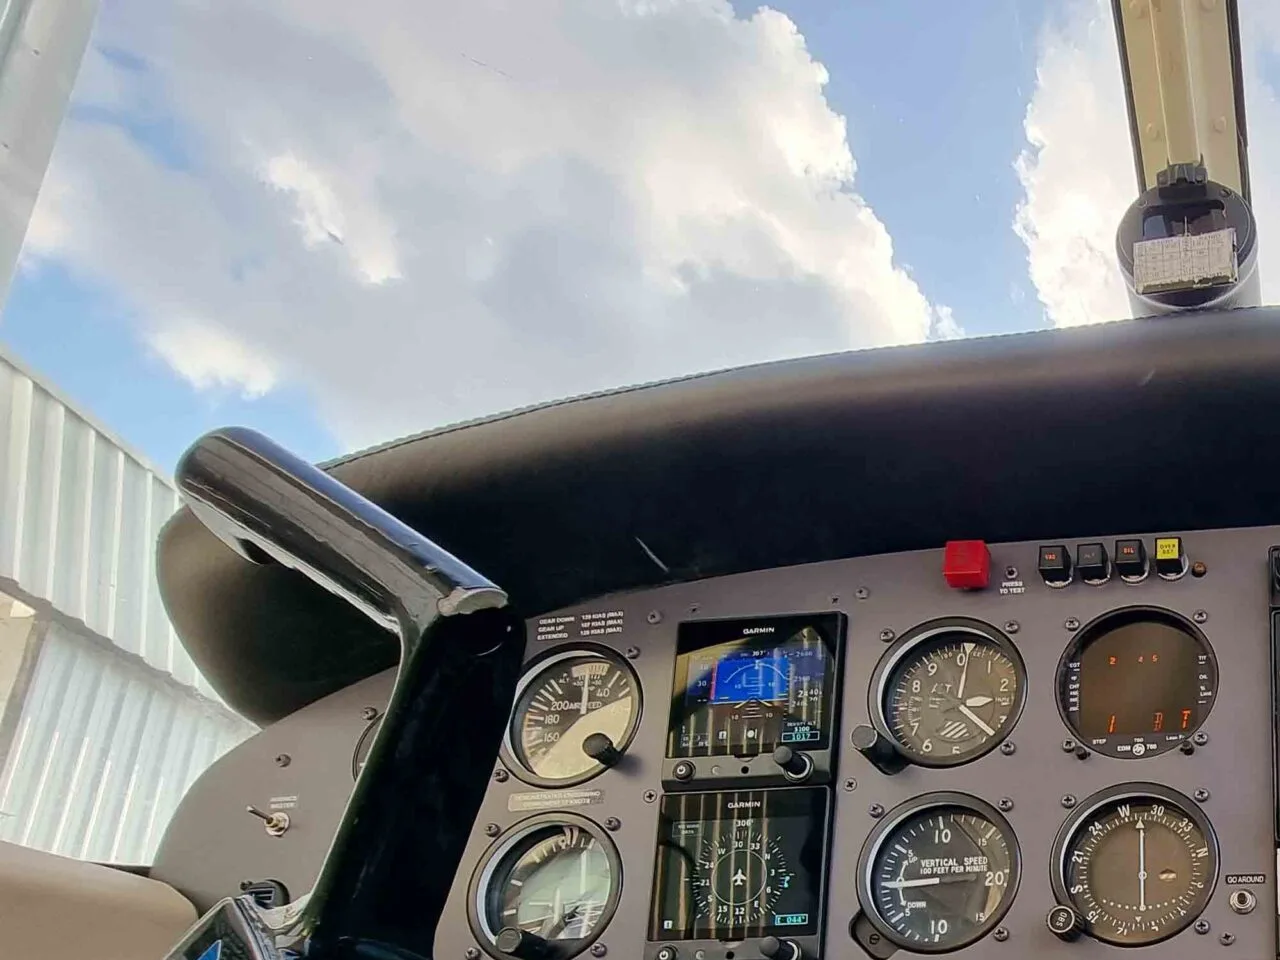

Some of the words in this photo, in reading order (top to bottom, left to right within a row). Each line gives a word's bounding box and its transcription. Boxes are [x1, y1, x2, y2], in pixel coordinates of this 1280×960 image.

[728, 800, 761, 809] GARMIN
[1117, 804, 1130, 817] W
[1151, 805, 1164, 816] 30
[1089, 822, 1102, 835] 24
[1179, 817, 1193, 832] 33
[935, 829, 951, 843] 10
[979, 838, 987, 846] 15
[921, 858, 958, 867] VERTICAL
[964, 857, 988, 865] SPEED
[966, 864, 987, 872] MINUTE
[985, 872, 1004, 886] 20
[931, 920, 947, 934] 10
